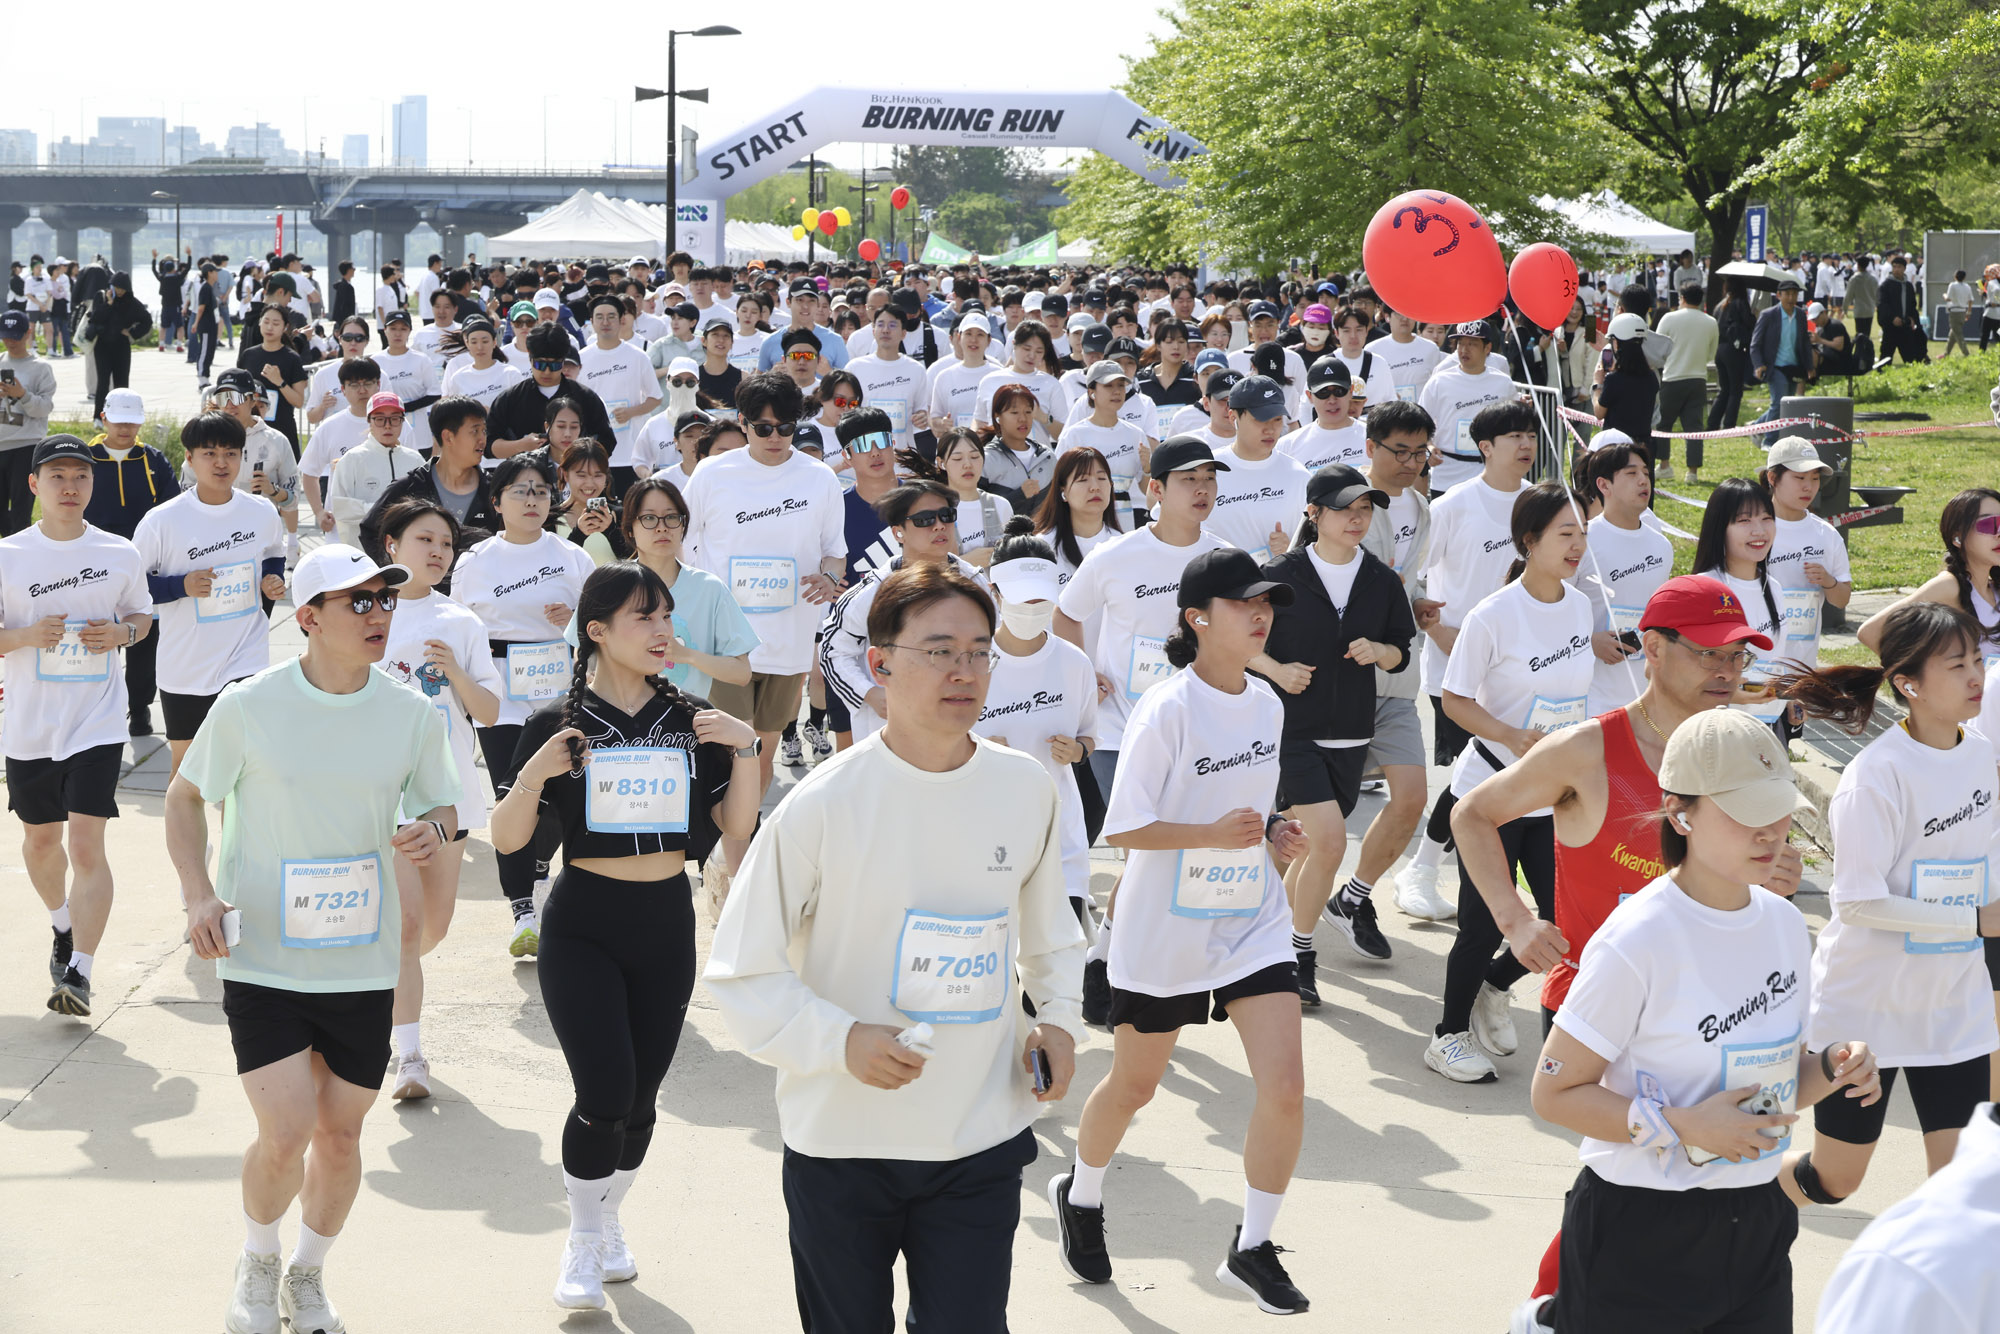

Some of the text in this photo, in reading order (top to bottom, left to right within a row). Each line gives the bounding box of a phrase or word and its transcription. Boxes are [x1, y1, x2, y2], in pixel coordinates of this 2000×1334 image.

[862, 105, 1064, 132] BURNING RUN
[711, 111, 808, 180] START
[1126, 118, 1200, 162] FINI
[1120, 339, 1134, 351] M
[587, 364, 628, 380] Burning Run
[487, 384, 503, 392] Run
[867, 376, 911, 392] Burning Run
[951, 385, 978, 397] Burning
[1455, 394, 1499, 410] Burning Run
[658, 441, 675, 450] Burn
[1120, 445, 1135, 454] Run
[1305, 448, 1364, 469] Burning Run
[1216, 487, 1285, 507] Burning Run
[735, 498, 809, 524] Burning Run
[187, 531, 256, 561] Burning Run
[1483, 536, 1514, 553] Burni
[1803, 546, 1825, 559] Run
[1609, 555, 1663, 582] Burning Run
[29, 567, 110, 598] Burning Run
[214, 581, 251, 598] 7345
[493, 564, 566, 598] Burning Run
[737, 577, 790, 590] M 7409
[1134, 582, 1180, 599] Burnin
[1786, 607, 1816, 619] 8345
[1529, 634, 1591, 673] Burning Run
[515, 661, 565, 677] W 8482
[1139, 662, 1175, 676] M 71
[534, 688, 552, 697] D-31
[978, 690, 1064, 722] Burning Run
[594, 754, 632, 763] BURNING
[633, 754, 651, 763] RUN
[1194, 751, 1253, 776] Burning
[1251, 740, 1277, 760] Run
[599, 778, 677, 796] W 8310
[1973, 789, 1992, 813] Run
[291, 867, 331, 876] BURNING
[332, 866, 351, 875] RUN
[1189, 865, 1260, 883] W 8074
[294, 888, 369, 911] M 7321
[912, 921, 962, 935] BURNING
[963, 925, 985, 936] RUN
[911, 951, 998, 978] M 7050
[1698, 991, 1769, 1043] Burning
[1766, 971, 1797, 1001] Run
[1734, 1053, 1779, 1067] BURNING
